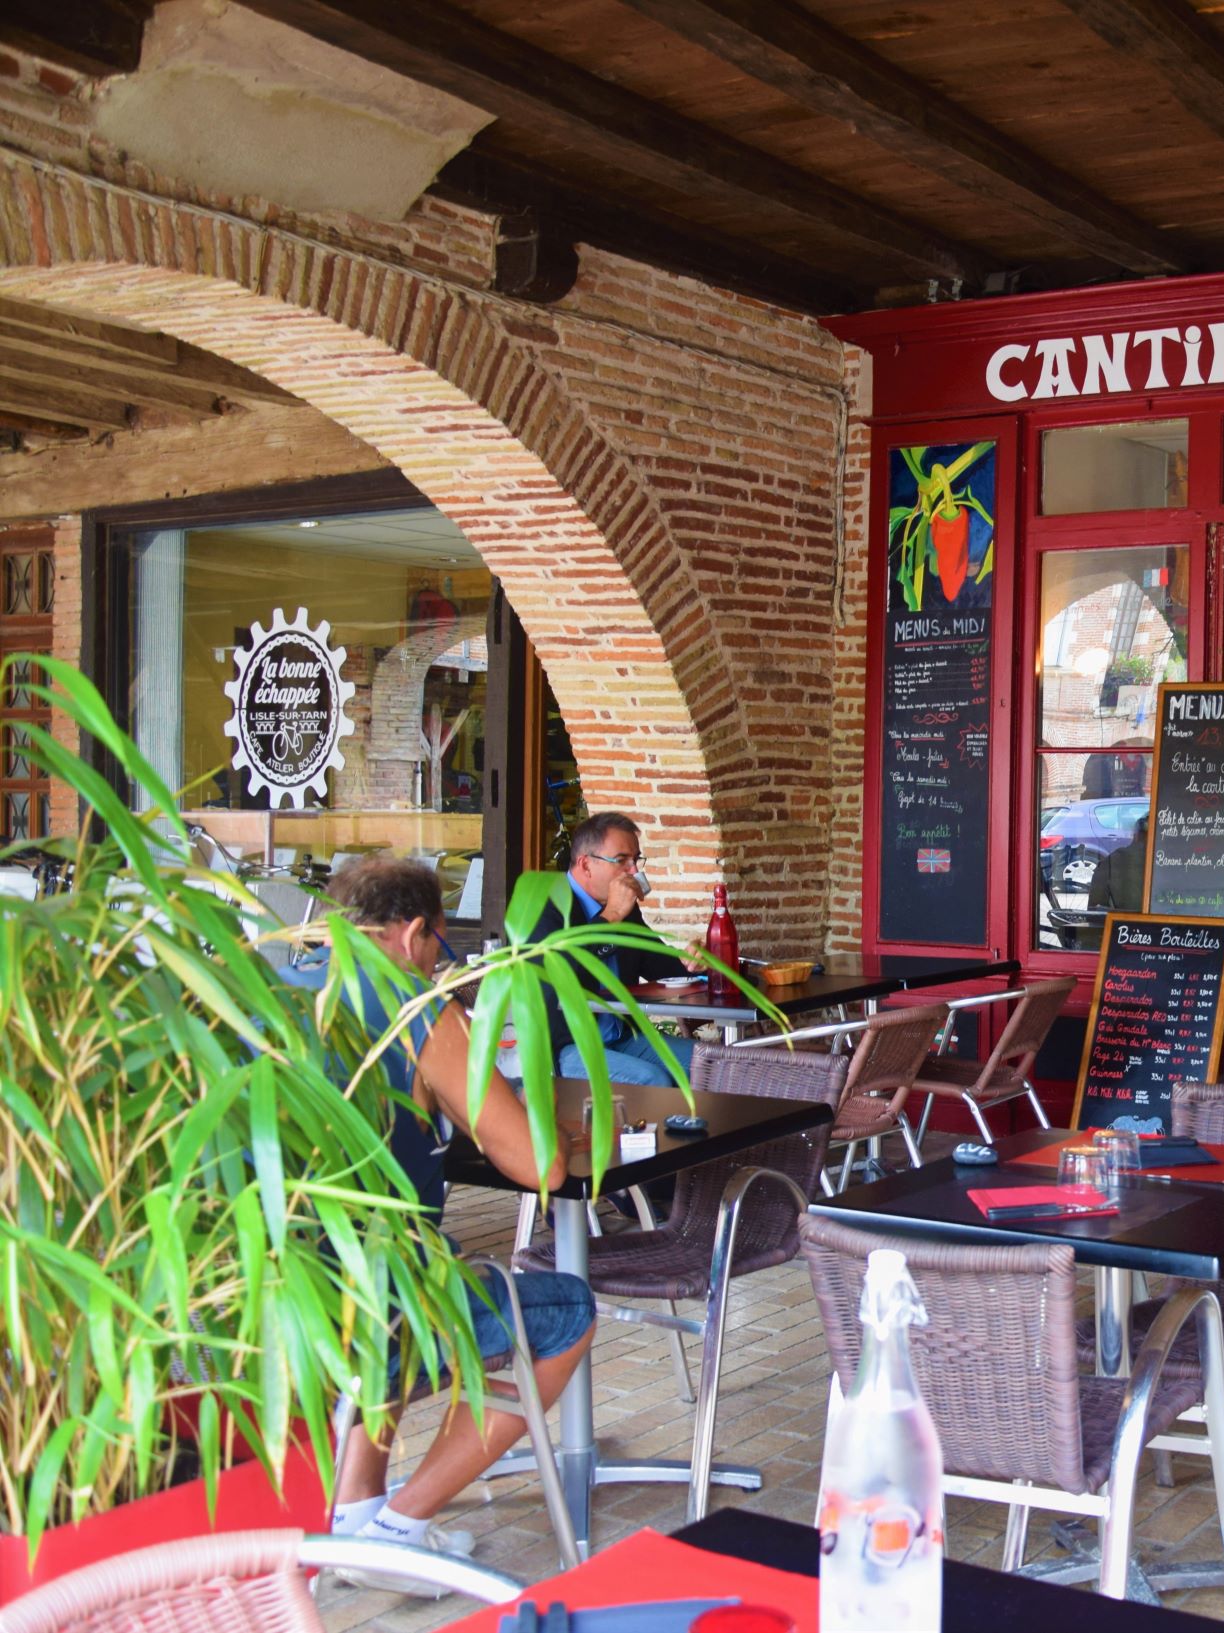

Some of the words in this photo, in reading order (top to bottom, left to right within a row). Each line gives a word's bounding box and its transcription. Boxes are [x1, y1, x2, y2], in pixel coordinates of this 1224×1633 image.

[894, 619, 940, 642] MENUS
[942, 627, 950, 635] du
[953, 618, 985, 634] MIDI
[261, 656, 277, 685] La
[279, 657, 322, 679] bonne
[255, 681, 321, 710] échappée
[1169, 694, 1223, 720] MENU
[298, 732, 327, 771] BOUTIQUE
[266, 757, 294, 773] ATELIER
[1186, 775, 1200, 792] la
[1117, 925, 1152, 944] Bières
[1160, 927, 1219, 949] Bouteilles
[1108, 965, 1157, 980] Hoegaarden
[1104, 979, 1134, 992] Carolus
[1089, 1065, 1124, 1079] Guinness
